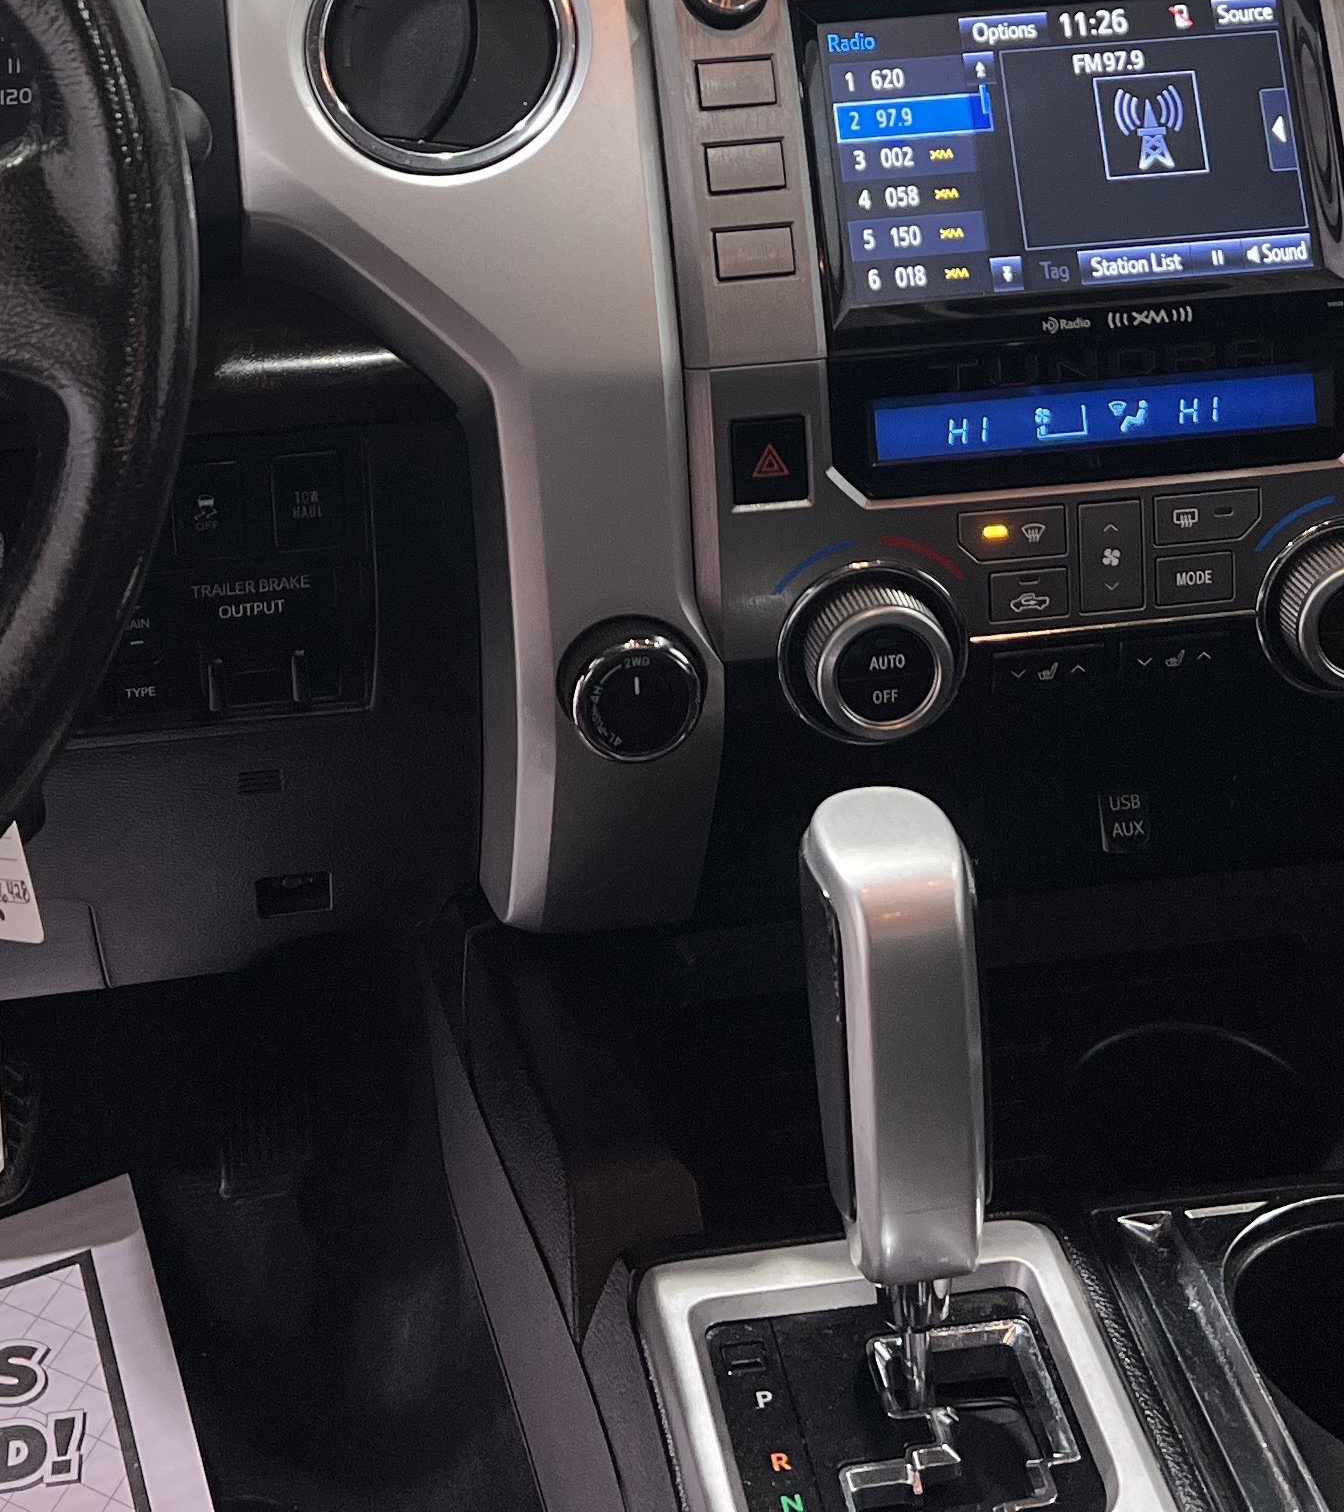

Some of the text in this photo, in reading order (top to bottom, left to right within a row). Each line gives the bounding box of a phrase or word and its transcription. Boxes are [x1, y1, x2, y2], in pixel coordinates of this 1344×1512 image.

[1058, 8, 1129, 39] 11:26
[1216, 4, 1274, 25] Source
[827, 32, 878, 53] Radio
[972, 21, 1038, 45] Options
[844, 68, 905, 92] 1 620
[0, 87, 33, 106] 120
[849, 107, 913, 130] 2 97.9
[853, 149, 866, 170] 3
[880, 146, 915, 169] 002
[858, 189, 871, 209] 4
[884, 185, 920, 207] 058
[862, 229, 875, 250] 5
[889, 225, 922, 247] 150
[1261, 241, 1307, 263] Sound
[1039, 260, 1070, 283] Tag
[1090, 252, 1184, 278] Station List
[867, 268, 881, 290] 6
[894, 265, 927, 288] 018
[1060, 317, 1091, 330] Radio
[1179, 395, 1219, 425] HI
[947, 416, 990, 446] HI
[292, 505, 323, 519] HAUL
[191, 574, 311, 599] TRAILER BRAKE
[1176, 570, 1212, 587] MODE
[218, 599, 286, 619] OUTPUT
[623, 655, 651, 669] 2WD
[869, 653, 906, 672] AUTO
[124, 686, 156, 699] TYPE
[872, 688, 899, 706] OFF
[1109, 794, 1141, 811] USB
[1112, 820, 1145, 837] AUX
[755, 1390, 773, 1409] P
[770, 1452, 792, 1472] R
[780, 1493, 804, 1512] N
